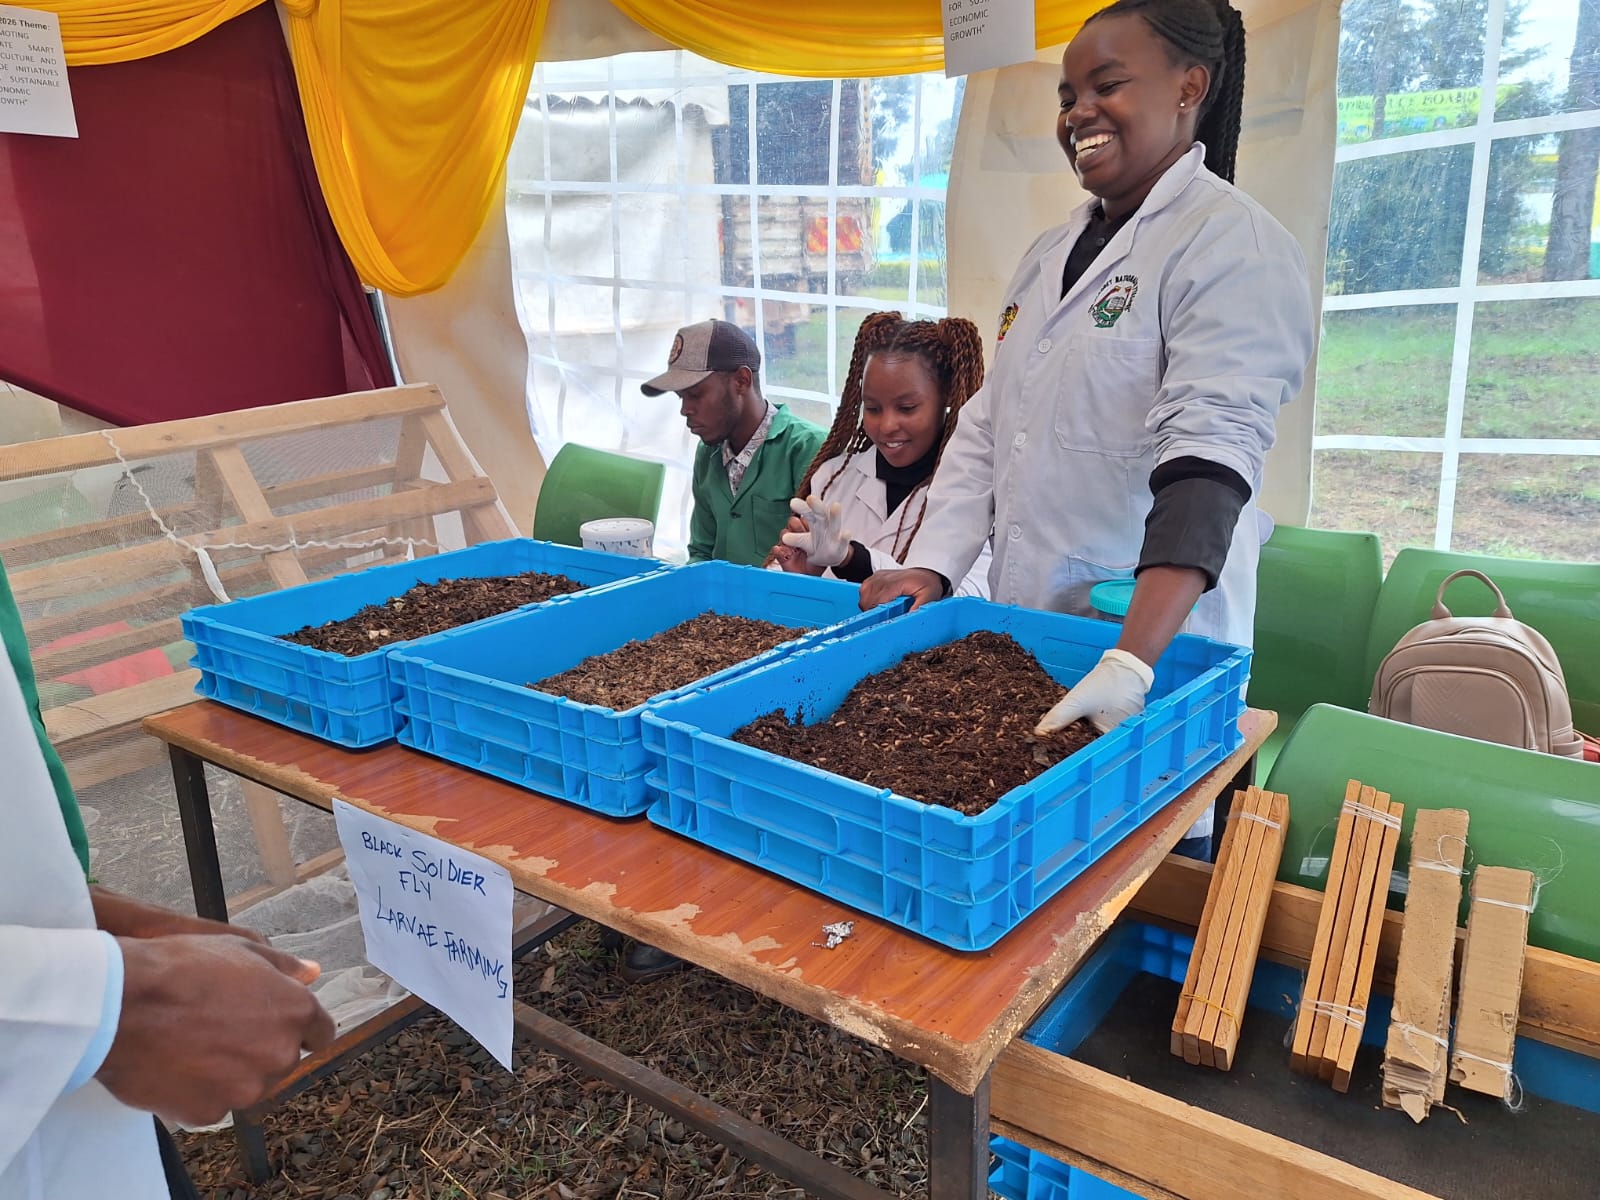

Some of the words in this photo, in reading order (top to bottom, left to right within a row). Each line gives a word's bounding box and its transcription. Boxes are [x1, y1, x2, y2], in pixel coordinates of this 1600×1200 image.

[949, 1, 962, 11] FOR
[950, 9, 989, 26] ECONOMIC
[19, 20, 52, 30] Theme:
[28, 44, 55, 53] SMART
[40, 57, 57, 65] AND
[16, 66, 59, 76] INITIATIVES
[10, 76, 60, 87] SUSTAINABLE
[361, 832, 402, 859] BLACK
[399, 870, 432, 901] FLY
[376, 886, 438, 948] LARVAE
[443, 931, 508, 998] FARMING
